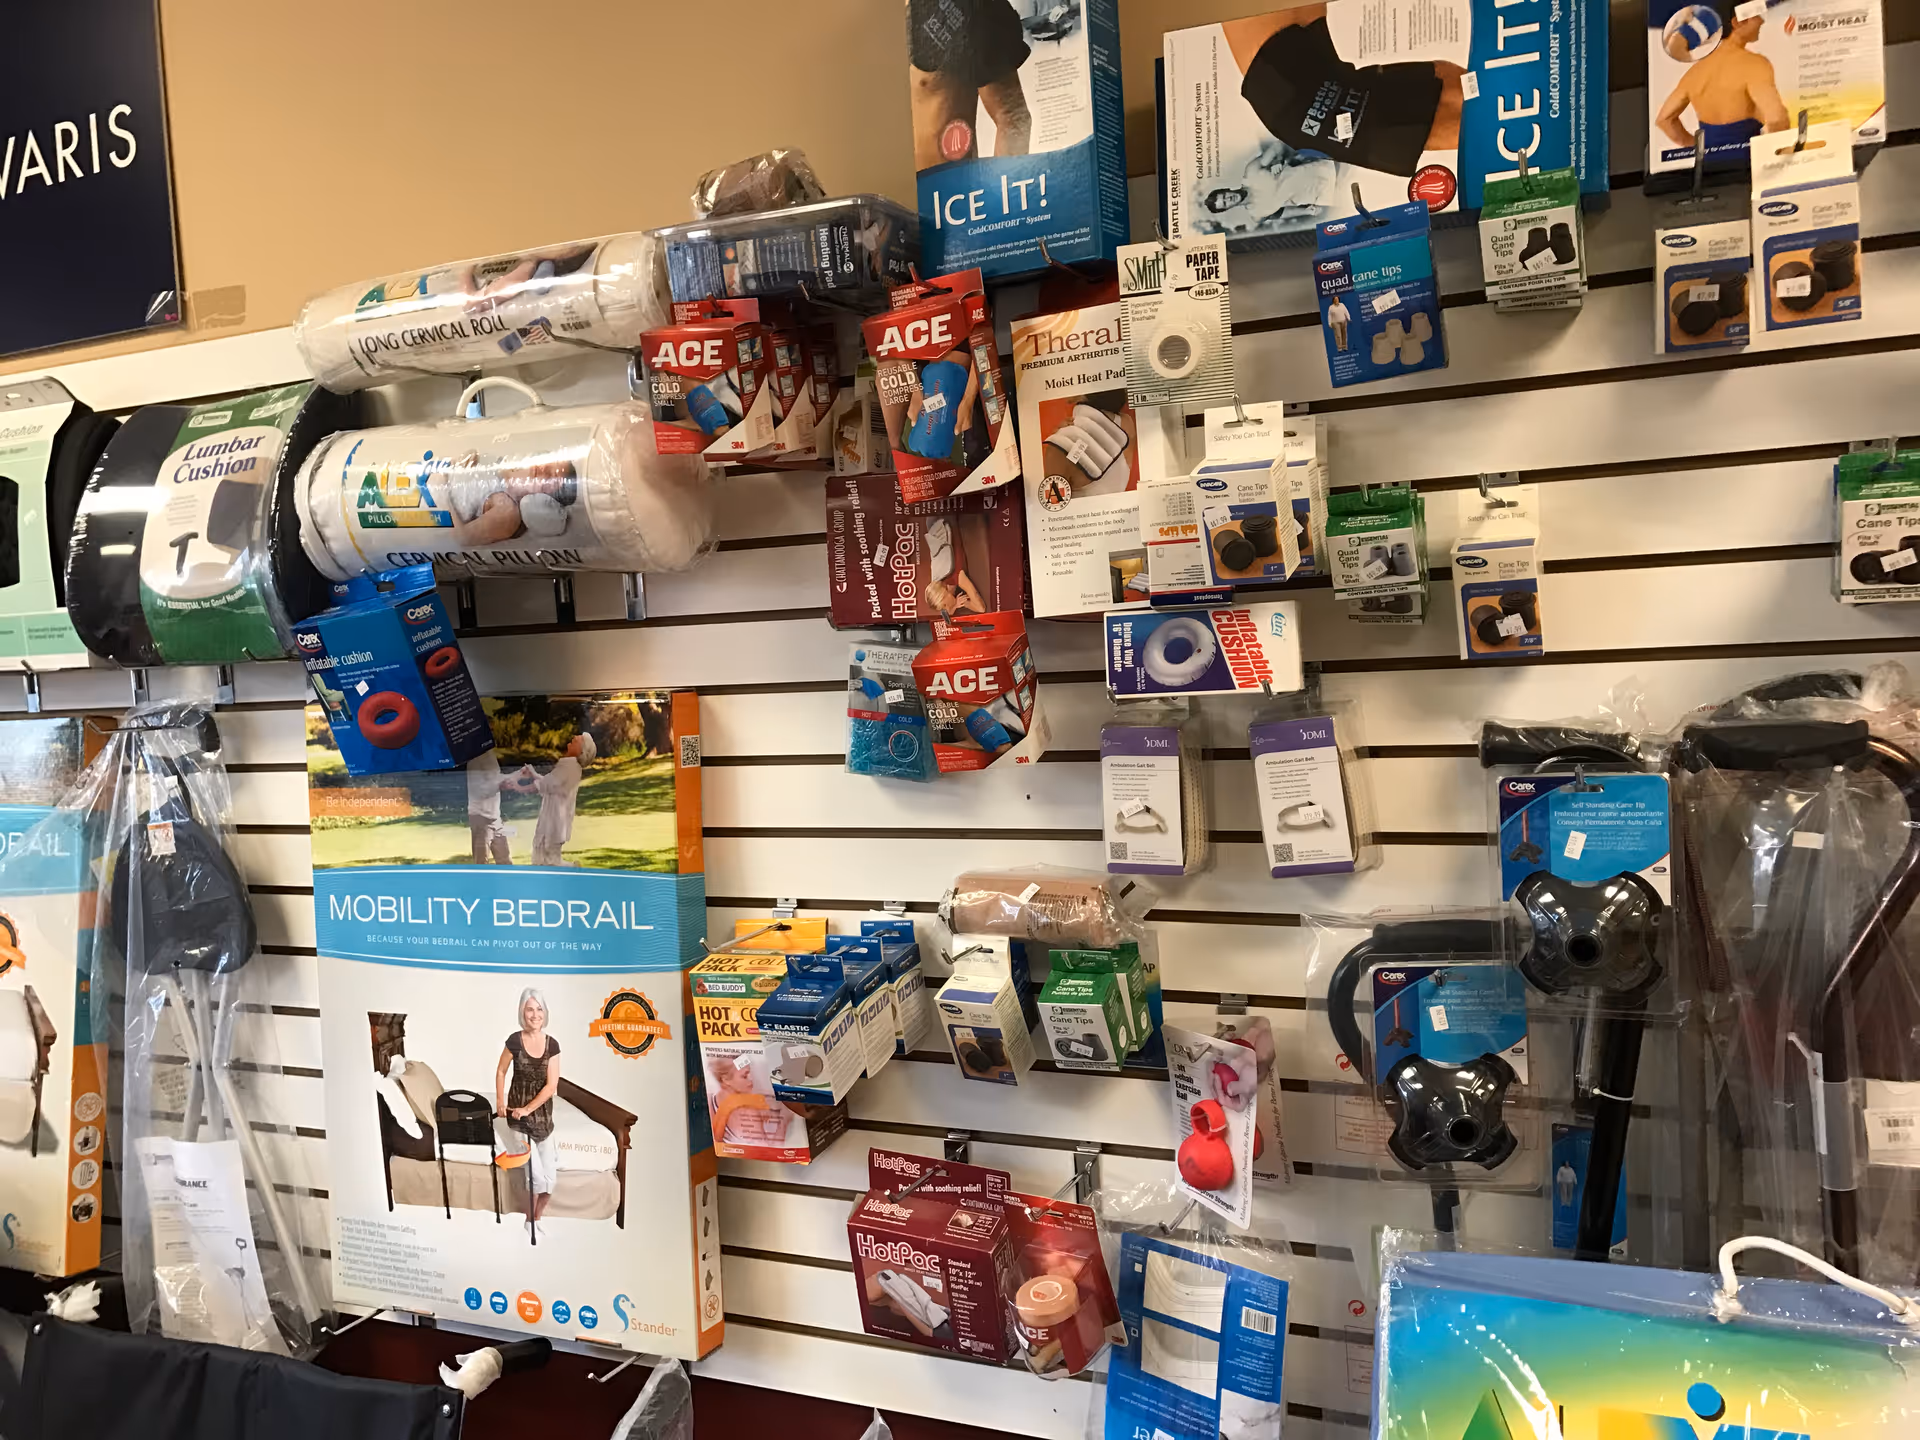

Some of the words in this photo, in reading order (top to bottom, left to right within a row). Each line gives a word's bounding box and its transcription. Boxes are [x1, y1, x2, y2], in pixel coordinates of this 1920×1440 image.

[1797, 22, 1833, 33] MOIST
[1194, 82, 1204, 112] System
[1485, 87, 1542, 183] ICE
[1424, 168, 1448, 178] Therapy
[1170, 168, 1179, 199] CREEK
[933, 188, 988, 231] ICE
[1000, 173, 1049, 216] IT!
[1812, 205, 1833, 216] Cane
[1834, 201, 1853, 213] Tips
[1026, 213, 1051, 225] System
[1171, 201, 1181, 233] BATTLE
[1327, 222, 1348, 233] Carex
[1491, 232, 1515, 244] Quad
[819, 228, 831, 268] Heating
[1492, 241, 1515, 252] Cane
[1495, 249, 1514, 258] Tips
[1186, 251, 1220, 268] PAPER
[1321, 260, 1344, 273] Carex
[824, 270, 836, 289] Pad
[1195, 266, 1220, 281] TAPE
[1321, 274, 1349, 291] quad
[1352, 269, 1379, 284] cane
[1382, 263, 1403, 279] tips
[1527, 279, 1544, 287] FOUR
[358, 331, 401, 354] LONG
[401, 319, 470, 348] CERVICAL
[877, 313, 954, 357] ACE
[651, 339, 724, 368] ACE
[1021, 357, 1065, 371] PREMIUM
[1067, 347, 1120, 363] ARTHRITIS
[878, 361, 918, 378] REUSABLE
[650, 375, 683, 383] REUSABLE
[880, 371, 917, 390] COLD
[1045, 378, 1074, 391] Moist
[1077, 372, 1102, 385] Heat
[1105, 367, 1126, 380] Pad
[651, 383, 681, 394] COLD
[882, 383, 925, 398] COMPRESS
[652, 392, 687, 401] COMPRESS
[653, 399, 675, 407] SMALL
[884, 396, 910, 406] LARGE
[182, 434, 266, 463] Lumbar
[731, 441, 745, 449] 3M
[773, 442, 786, 450] 3M
[1290, 440, 1305, 448] Trust
[172, 455, 258, 485] Cushion
[981, 475, 996, 485] 3M
[1291, 480, 1304, 490] Tips
[1237, 484, 1254, 493] Cane
[1255, 482, 1269, 492] Tips
[846, 479, 862, 511] relief!
[1090, 509, 1102, 517] heat
[833, 509, 845, 535] GROUP
[1856, 518, 1893, 530] Cane
[1896, 514, 1920, 529] Tips
[854, 511, 870, 556] soothing
[1063, 541, 1083, 549] healing
[834, 535, 847, 583] CHATTANOOGA
[1337, 549, 1359, 559] Quad
[1338, 556, 1359, 565] Cane
[859, 556, 875, 581] with
[889, 522, 917, 620] HotPac
[1052, 568, 1074, 577] Reusable
[1341, 562, 1359, 573] Tips
[1498, 562, 1515, 571] Cane
[1516, 560, 1530, 570] Tips
[865, 580, 883, 619] Packed
[1193, 593, 1225, 602] Tensoplast
[406, 603, 435, 621] Carex
[411, 624, 443, 643] inflatable
[1121, 621, 1133, 647] Deluxe
[297, 632, 321, 650] Carex
[415, 636, 443, 653] cushion
[1232, 609, 1275, 685] Inflatable
[1211, 611, 1260, 689] CUSHION
[304, 653, 341, 672] inflatable
[341, 650, 374, 667] cushion
[1114, 642, 1123, 673] Diameter
[1125, 648, 1135, 668] Vinyl
[888, 680, 907, 689] Sports
[925, 666, 999, 696] ACE
[926, 701, 960, 710] REUSABLE
[928, 708, 959, 719] COLD
[930, 716, 965, 725] COMPRESS
[932, 722, 954, 731] SMALL
[1015, 755, 1030, 764] 3M
[1265, 758, 1295, 767] Ambulation
[1509, 781, 1536, 793] Carex
[326, 796, 338, 807] Be
[340, 796, 400, 809] Independent
[1585, 802, 1615, 812] Standing
[330, 894, 481, 926] MOBILITY
[492, 898, 655, 931] BEDRAIL
[366, 934, 404, 945] BECAUSE
[406, 936, 430, 946] YOUR
[432, 937, 469, 948] BEDRAIL
[471, 938, 490, 948] CAN
[492, 939, 520, 949] PIVOT
[522, 940, 542, 950] OUT
[544, 941, 557, 951] OF
[560, 941, 580, 951] THE
[582, 942, 603, 952] WAY
[697, 964, 739, 973] PACK
[705, 957, 744, 966] HOT
[1382, 970, 1406, 983] Carex
[708, 984, 722, 993] BED
[723, 984, 743, 994] BUDDY
[754, 981, 778, 991] Balance
[1055, 986, 1075, 995] Cane
[1076, 986, 1093, 996] Tips
[699, 1006, 732, 1023] HOT
[741, 1009, 757, 1023] CO
[969, 1011, 984, 1020] Cane
[984, 1013, 993, 1021] Tips
[598, 1023, 626, 1032] LIFETIME
[775, 1025, 810, 1034] ELASTIC
[1048, 1016, 1073, 1026] Cane
[1074, 1018, 1094, 1030] Tips
[702, 1021, 743, 1040] PACK
[1175, 1081, 1202, 1097] Exercise
[1175, 1090, 1188, 1101] Ball
[1245, 1100, 1254, 1121] Living
[1243, 1123, 1251, 1139] Better
[873, 1152, 921, 1175] HotPac
[921, 1184, 934, 1194] with
[935, 1185, 962, 1196] soothing
[962, 1184, 981, 1195] relief!
[863, 1199, 913, 1219] HotPac
[856, 1233, 941, 1273] HotPac
[947, 1258, 971, 1270] Standard
[630, 1317, 678, 1337] Stander
